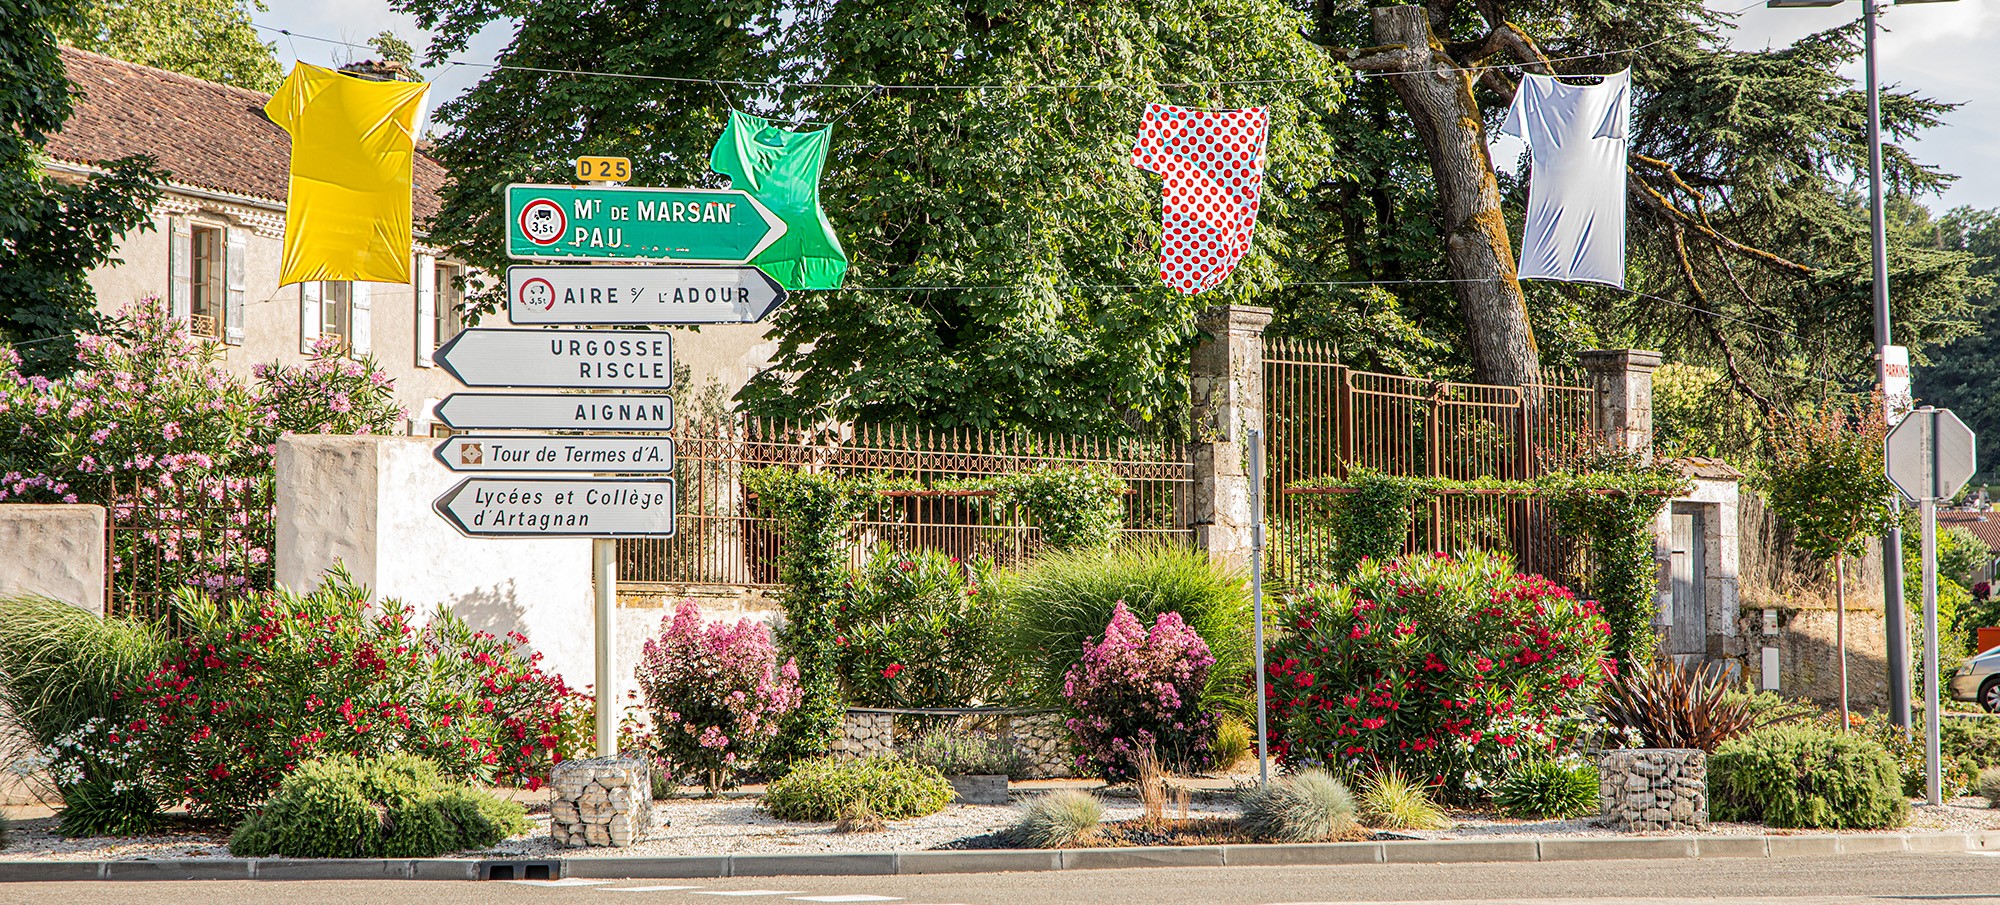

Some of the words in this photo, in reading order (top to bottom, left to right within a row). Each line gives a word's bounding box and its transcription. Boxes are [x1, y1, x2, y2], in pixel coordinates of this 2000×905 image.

[580, 160, 591, 177] D
[600, 161, 627, 178] 25
[611, 206, 629, 221] DE
[637, 201, 732, 223] MARSAN
[531, 221, 554, 234] 3,5t
[575, 228, 622, 248] PAU
[563, 287, 619, 304] AIRE
[658, 287, 750, 304] L'ADOUR
[551, 340, 663, 357] URGOSSE
[579, 362, 664, 379] RISCLE
[1885, 363, 1909, 378] PARKING
[574, 404, 664, 421] AIGNAN
[491, 445, 530, 462] Tour
[536, 446, 557, 462] de
[564, 446, 626, 463] Termes
[632, 446, 664, 463] d'A.
[475, 487, 543, 506] Lycées
[554, 489, 574, 505] et
[586, 488, 664, 510] Collège
[473, 510, 590, 530] d'Artagnan
